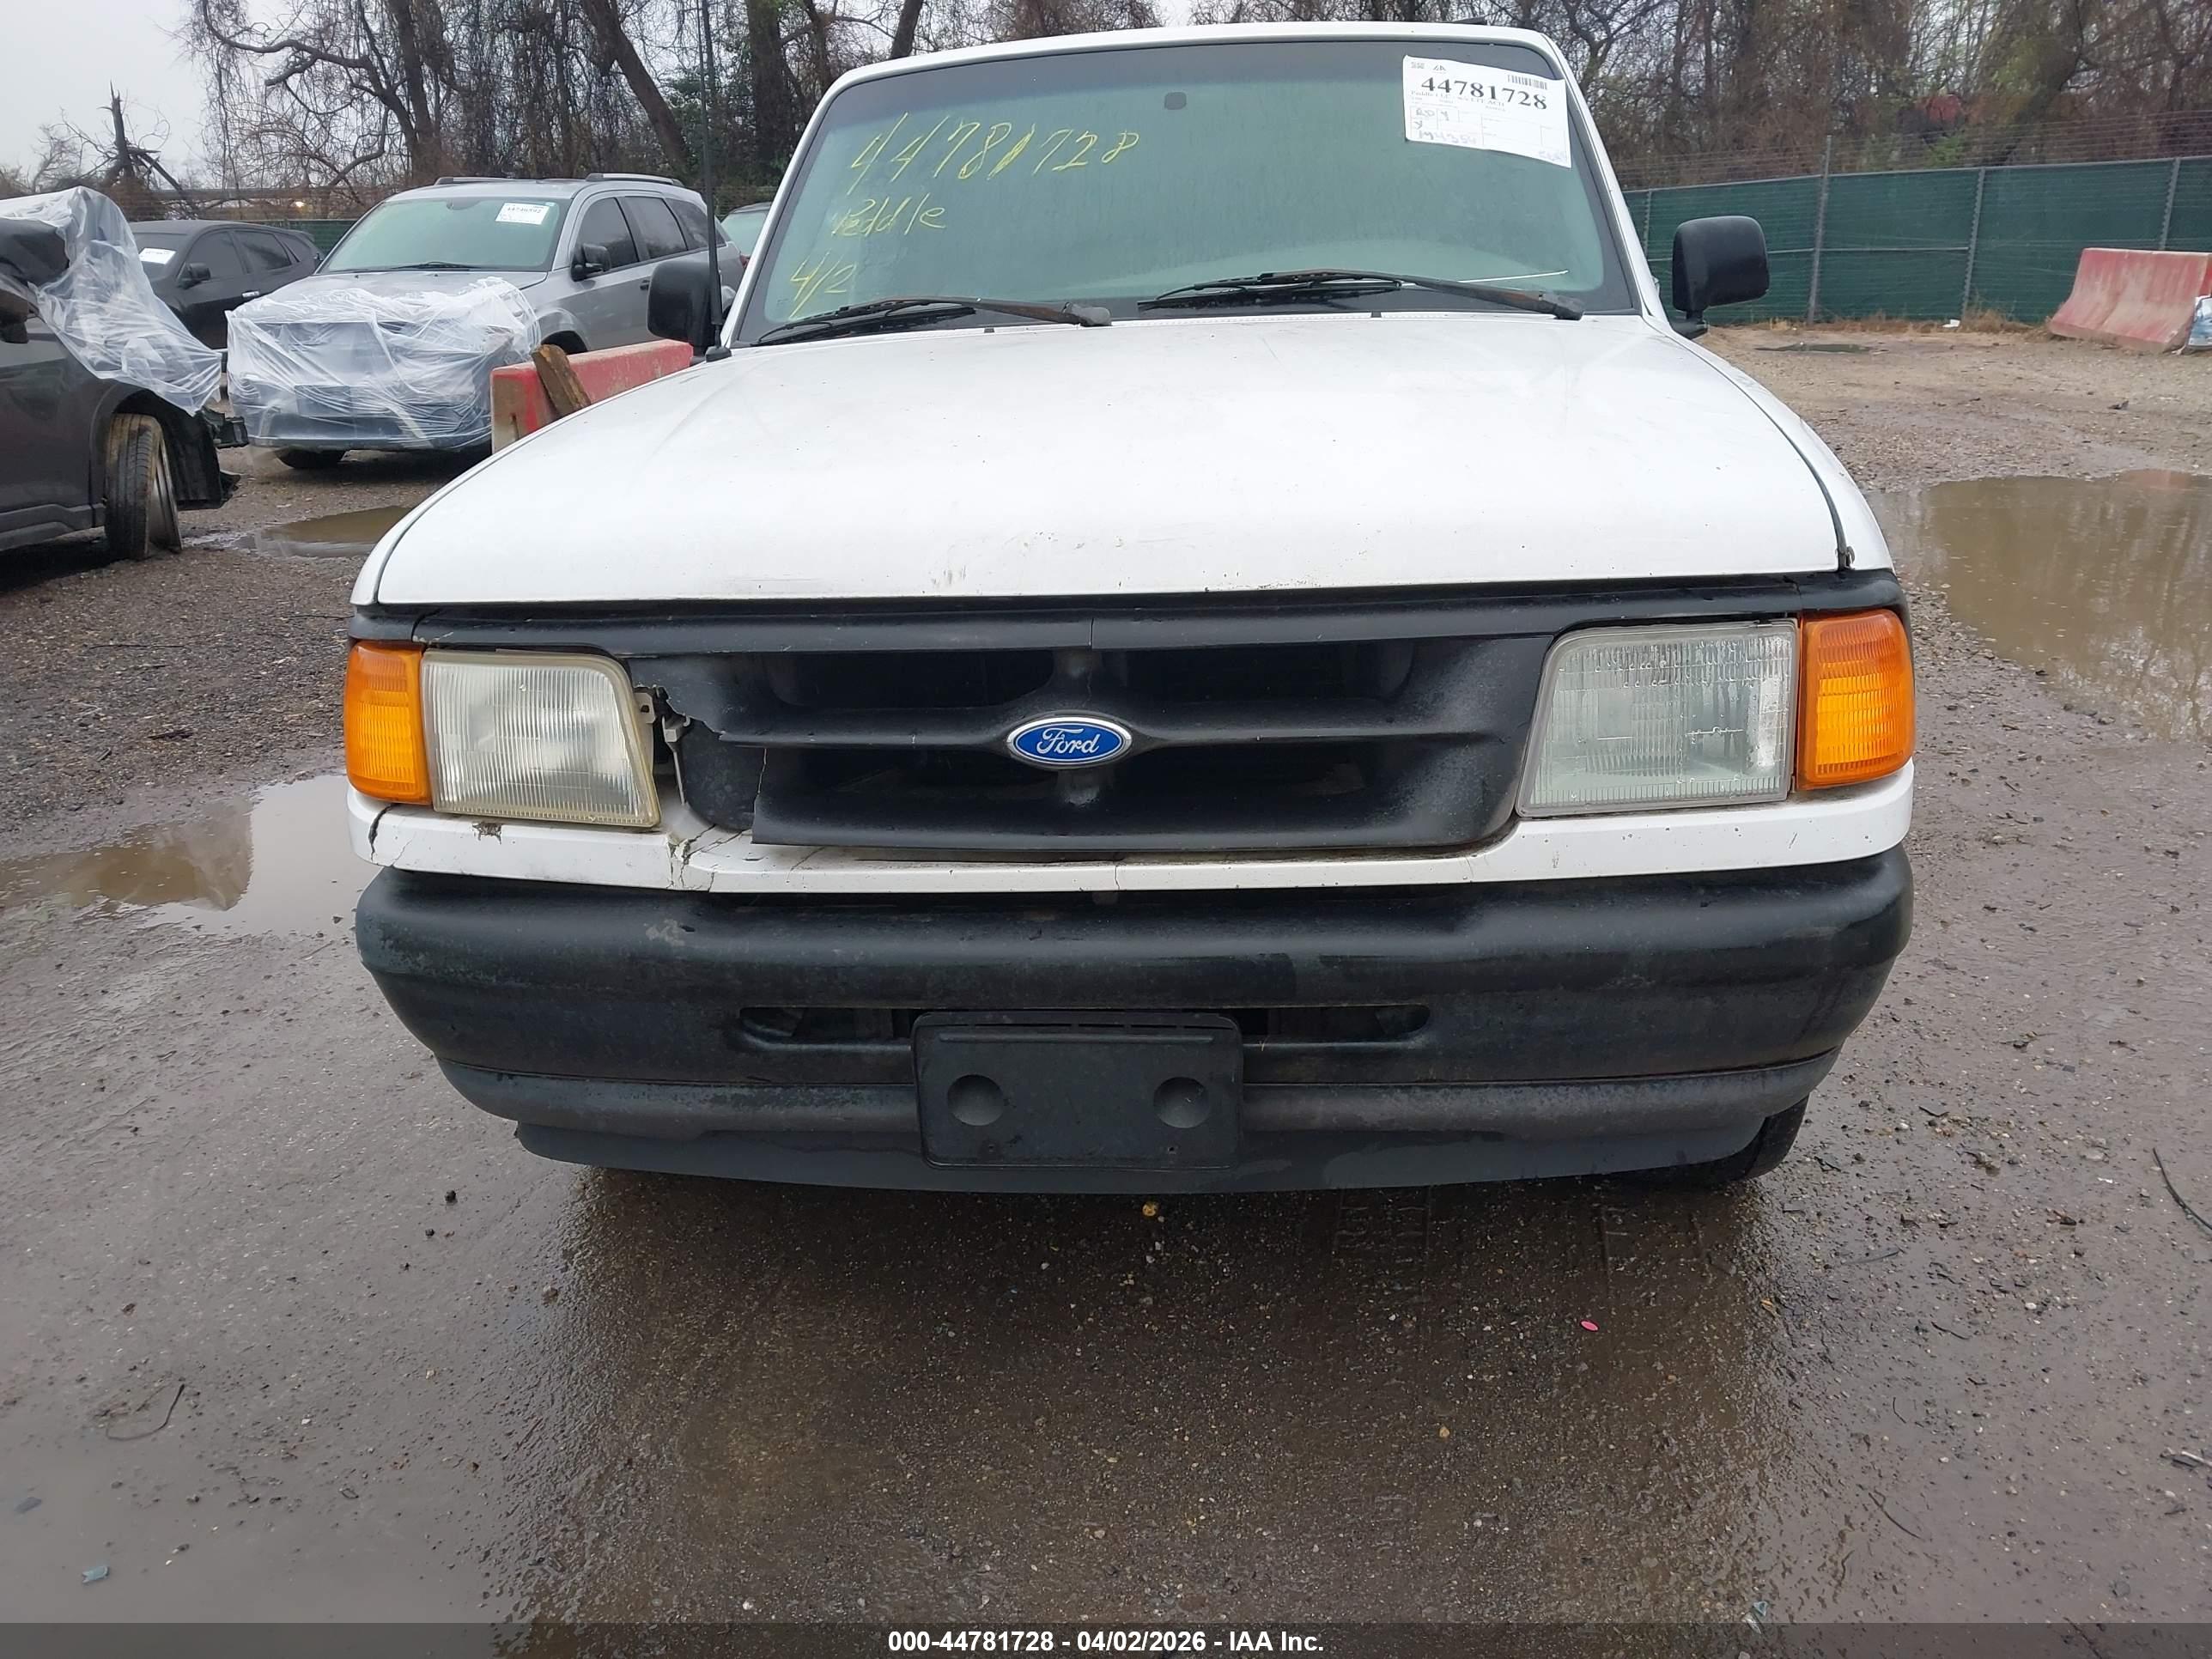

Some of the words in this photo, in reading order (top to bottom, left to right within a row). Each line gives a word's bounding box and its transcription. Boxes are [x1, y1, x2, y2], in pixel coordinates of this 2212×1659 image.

[1420, 76, 1547, 110] 44781728
[846, 112, 1139, 196] 44781728
[789, 249, 858, 319] 4/2
[1036, 727, 1100, 754] Ford
